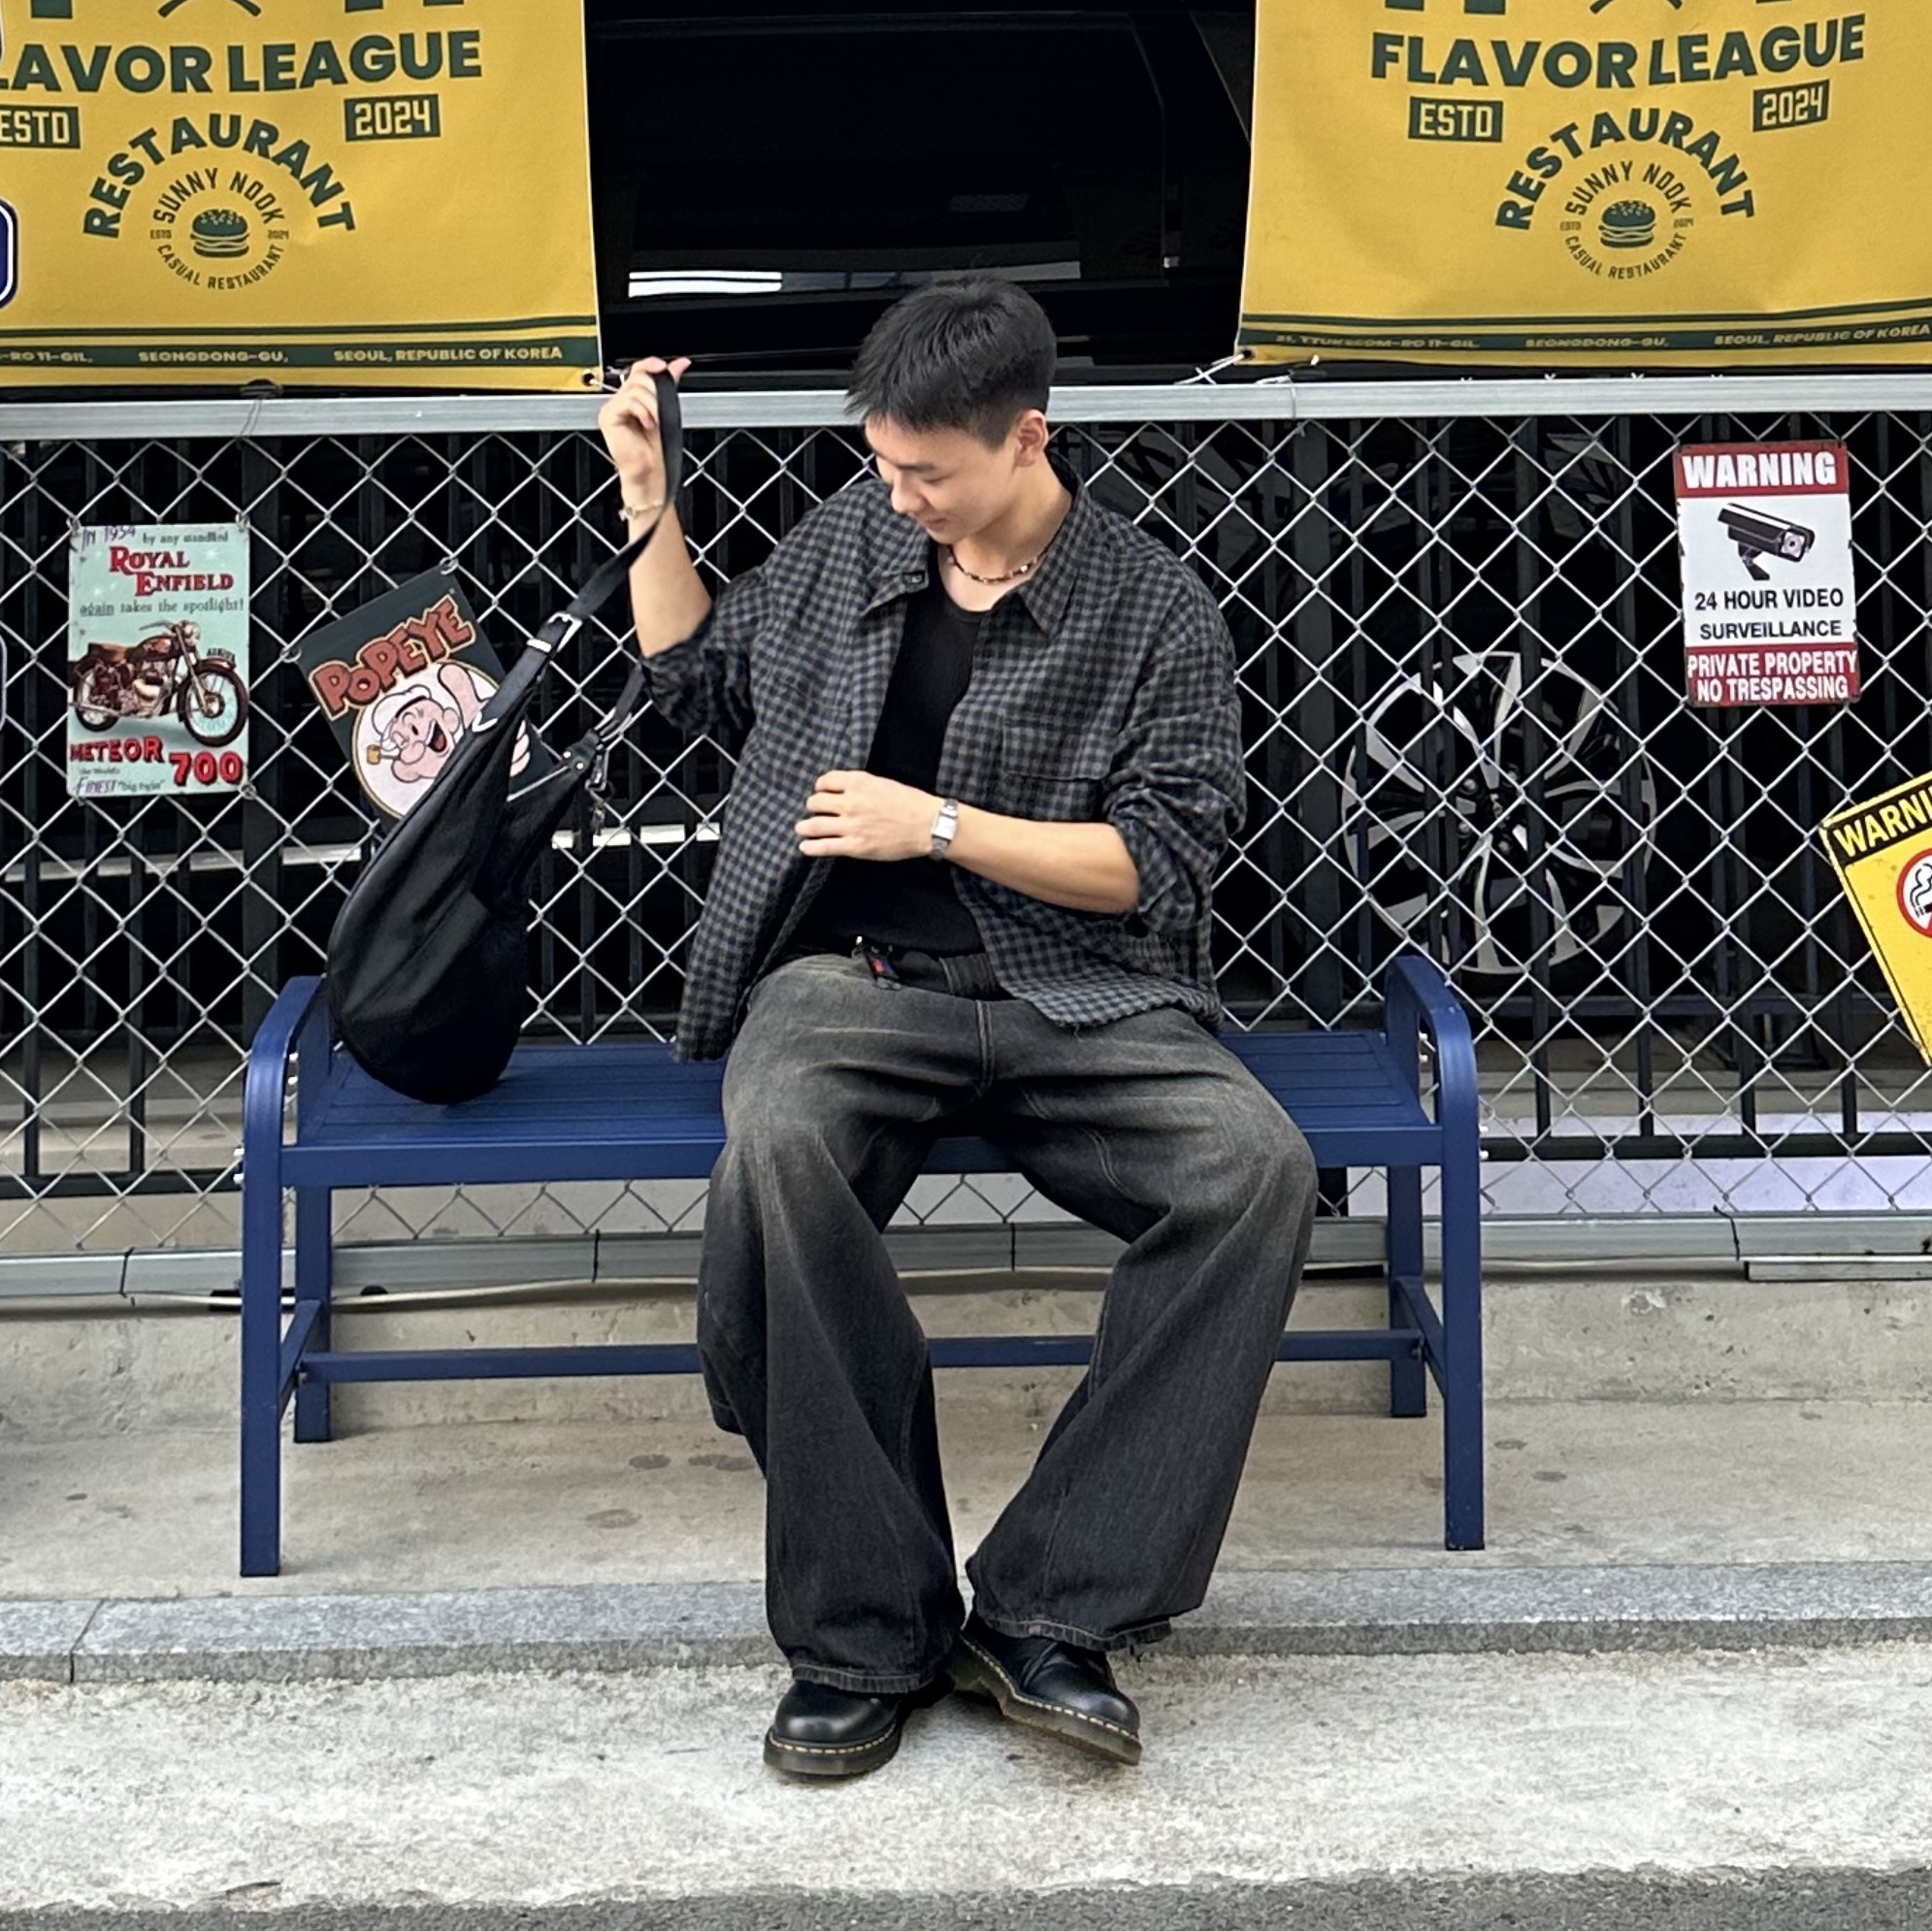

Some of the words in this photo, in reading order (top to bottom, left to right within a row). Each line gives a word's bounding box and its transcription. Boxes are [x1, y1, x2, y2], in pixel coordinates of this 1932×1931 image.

[0, 43, 213, 93] AVOR
[227, 30, 482, 92] LEAGUE
[1372, 32, 1638, 89] FLAVOR
[1649, 14, 1865, 85] LEAGUE
[354, 99, 432, 136] 2024
[1419, 102, 1494, 138] ESTD
[1761, 84, 1824, 127] 2024
[83, 114, 355, 239] RESTAURANT
[1494, 107, 1754, 231] RESTAURANT
[1564, 160, 1633, 215] SUNNY
[1642, 162, 1692, 214] NOOK
[152, 167, 218, 224] SUNNY
[229, 171, 285, 224] NOOK
[157, 244, 200, 286] CASUAL
[208, 244, 284, 290] RESTAURANT
[1565, 236, 1602, 277] CASUAL
[1608, 233, 1686, 280] RESTAURANT
[1773, 331, 1851, 344] REPUBLIC
[1852, 329, 1875, 340] OF
[1877, 323, 1931, 339] KOREA
[334, 350, 392, 363] SEOUL,
[395, 347, 475, 362] REPUBLIC
[479, 347, 501, 360] OF
[504, 345, 563, 360] KOREA
[1682, 451, 1838, 489] WARNING
[143, 533, 155, 545] by
[160, 535, 180, 545] any
[109, 545, 190, 575] ROYAL
[135, 571, 235, 597] ENFIELD
[1694, 591, 1718, 611] 24
[1724, 589, 1778, 609] HOUR
[1783, 587, 1844, 607] VIDEO
[80, 603, 115, 617] again
[120, 600, 152, 613] takes
[158, 599, 177, 612] the
[183, 596, 245, 614] spotlight!
[1699, 619, 1842, 640] SURVEILLANCE
[1687, 653, 1759, 678] PRIVATE
[1764, 650, 1857, 675] PROPERTY
[1697, 678, 1722, 703] NO
[1727, 674, 1849, 701] TRESPASSING
[70, 735, 165, 763] METEOR
[169, 750, 244, 787] 700
[1833, 785, 1932, 858] WARNI
